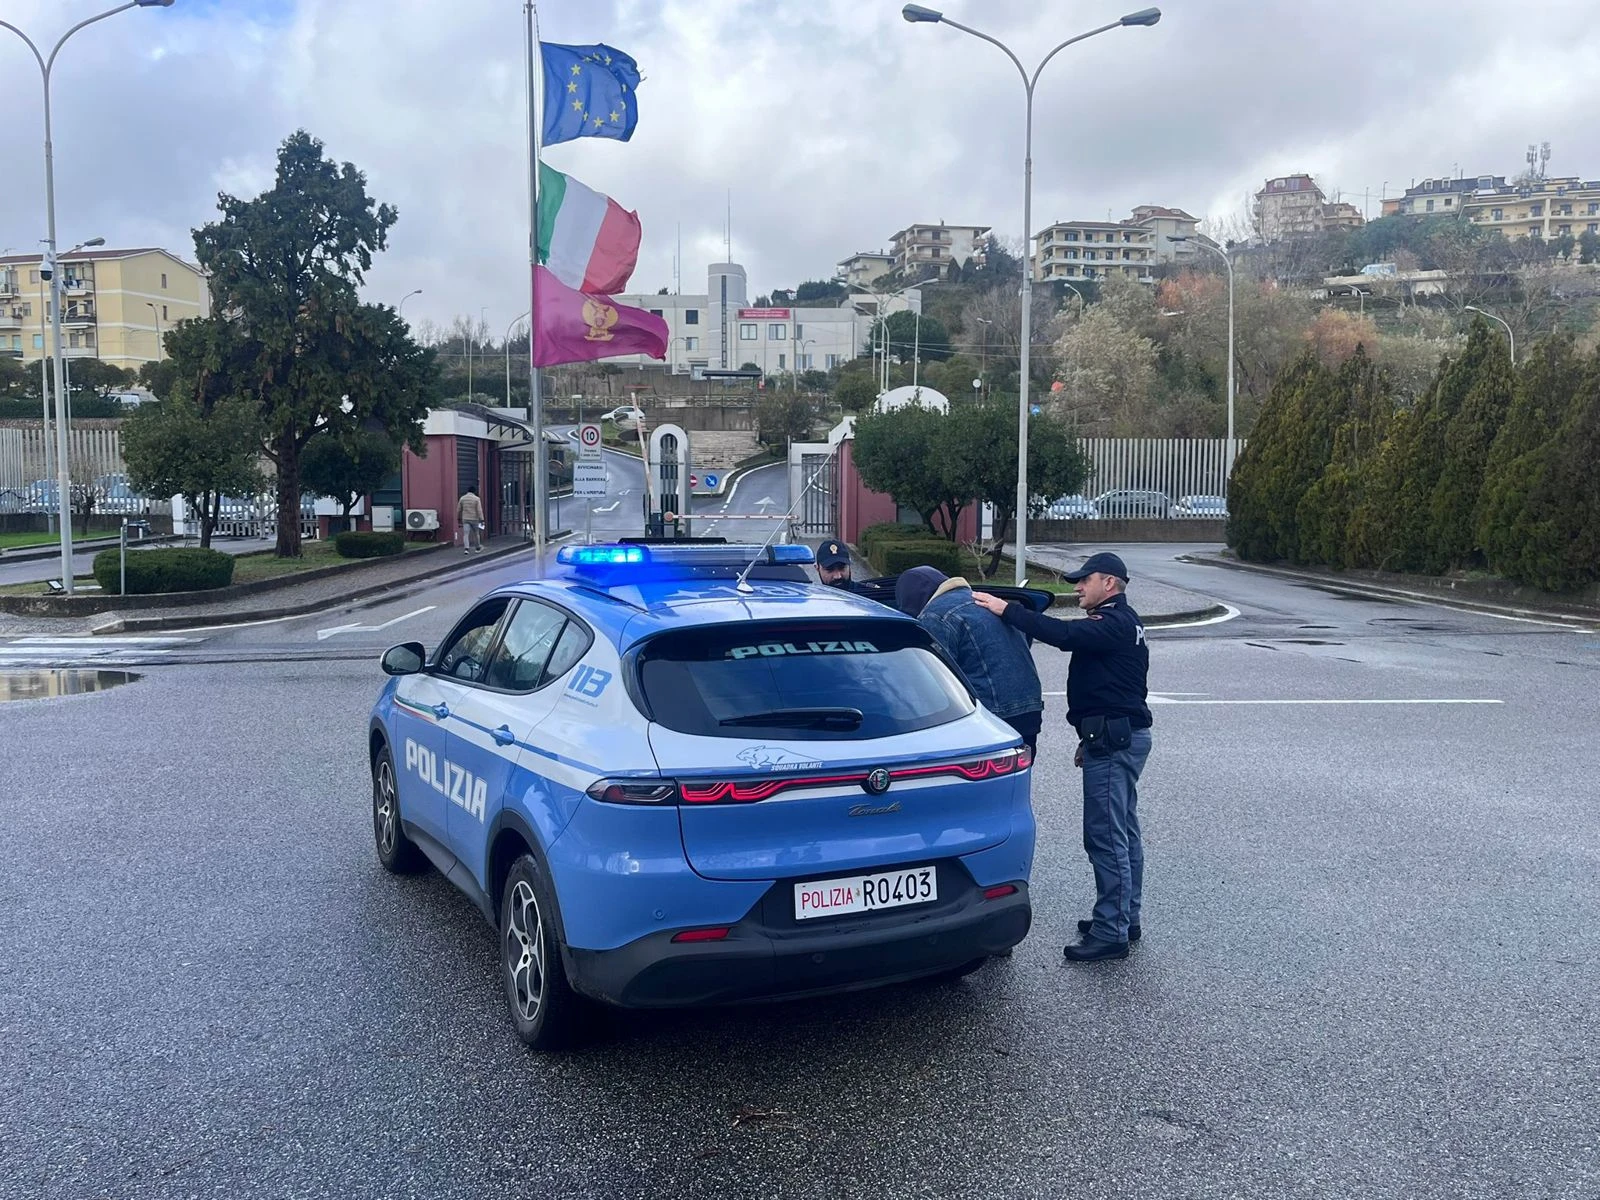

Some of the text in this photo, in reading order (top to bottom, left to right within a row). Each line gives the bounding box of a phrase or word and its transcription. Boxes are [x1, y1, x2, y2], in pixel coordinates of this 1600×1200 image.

[586, 431, 595, 441] 10
[729, 641, 880, 659] POLIZIA
[568, 664, 612, 698] 113
[405, 738, 488, 824] POLIZIA
[801, 887, 854, 910] POLIZIA
